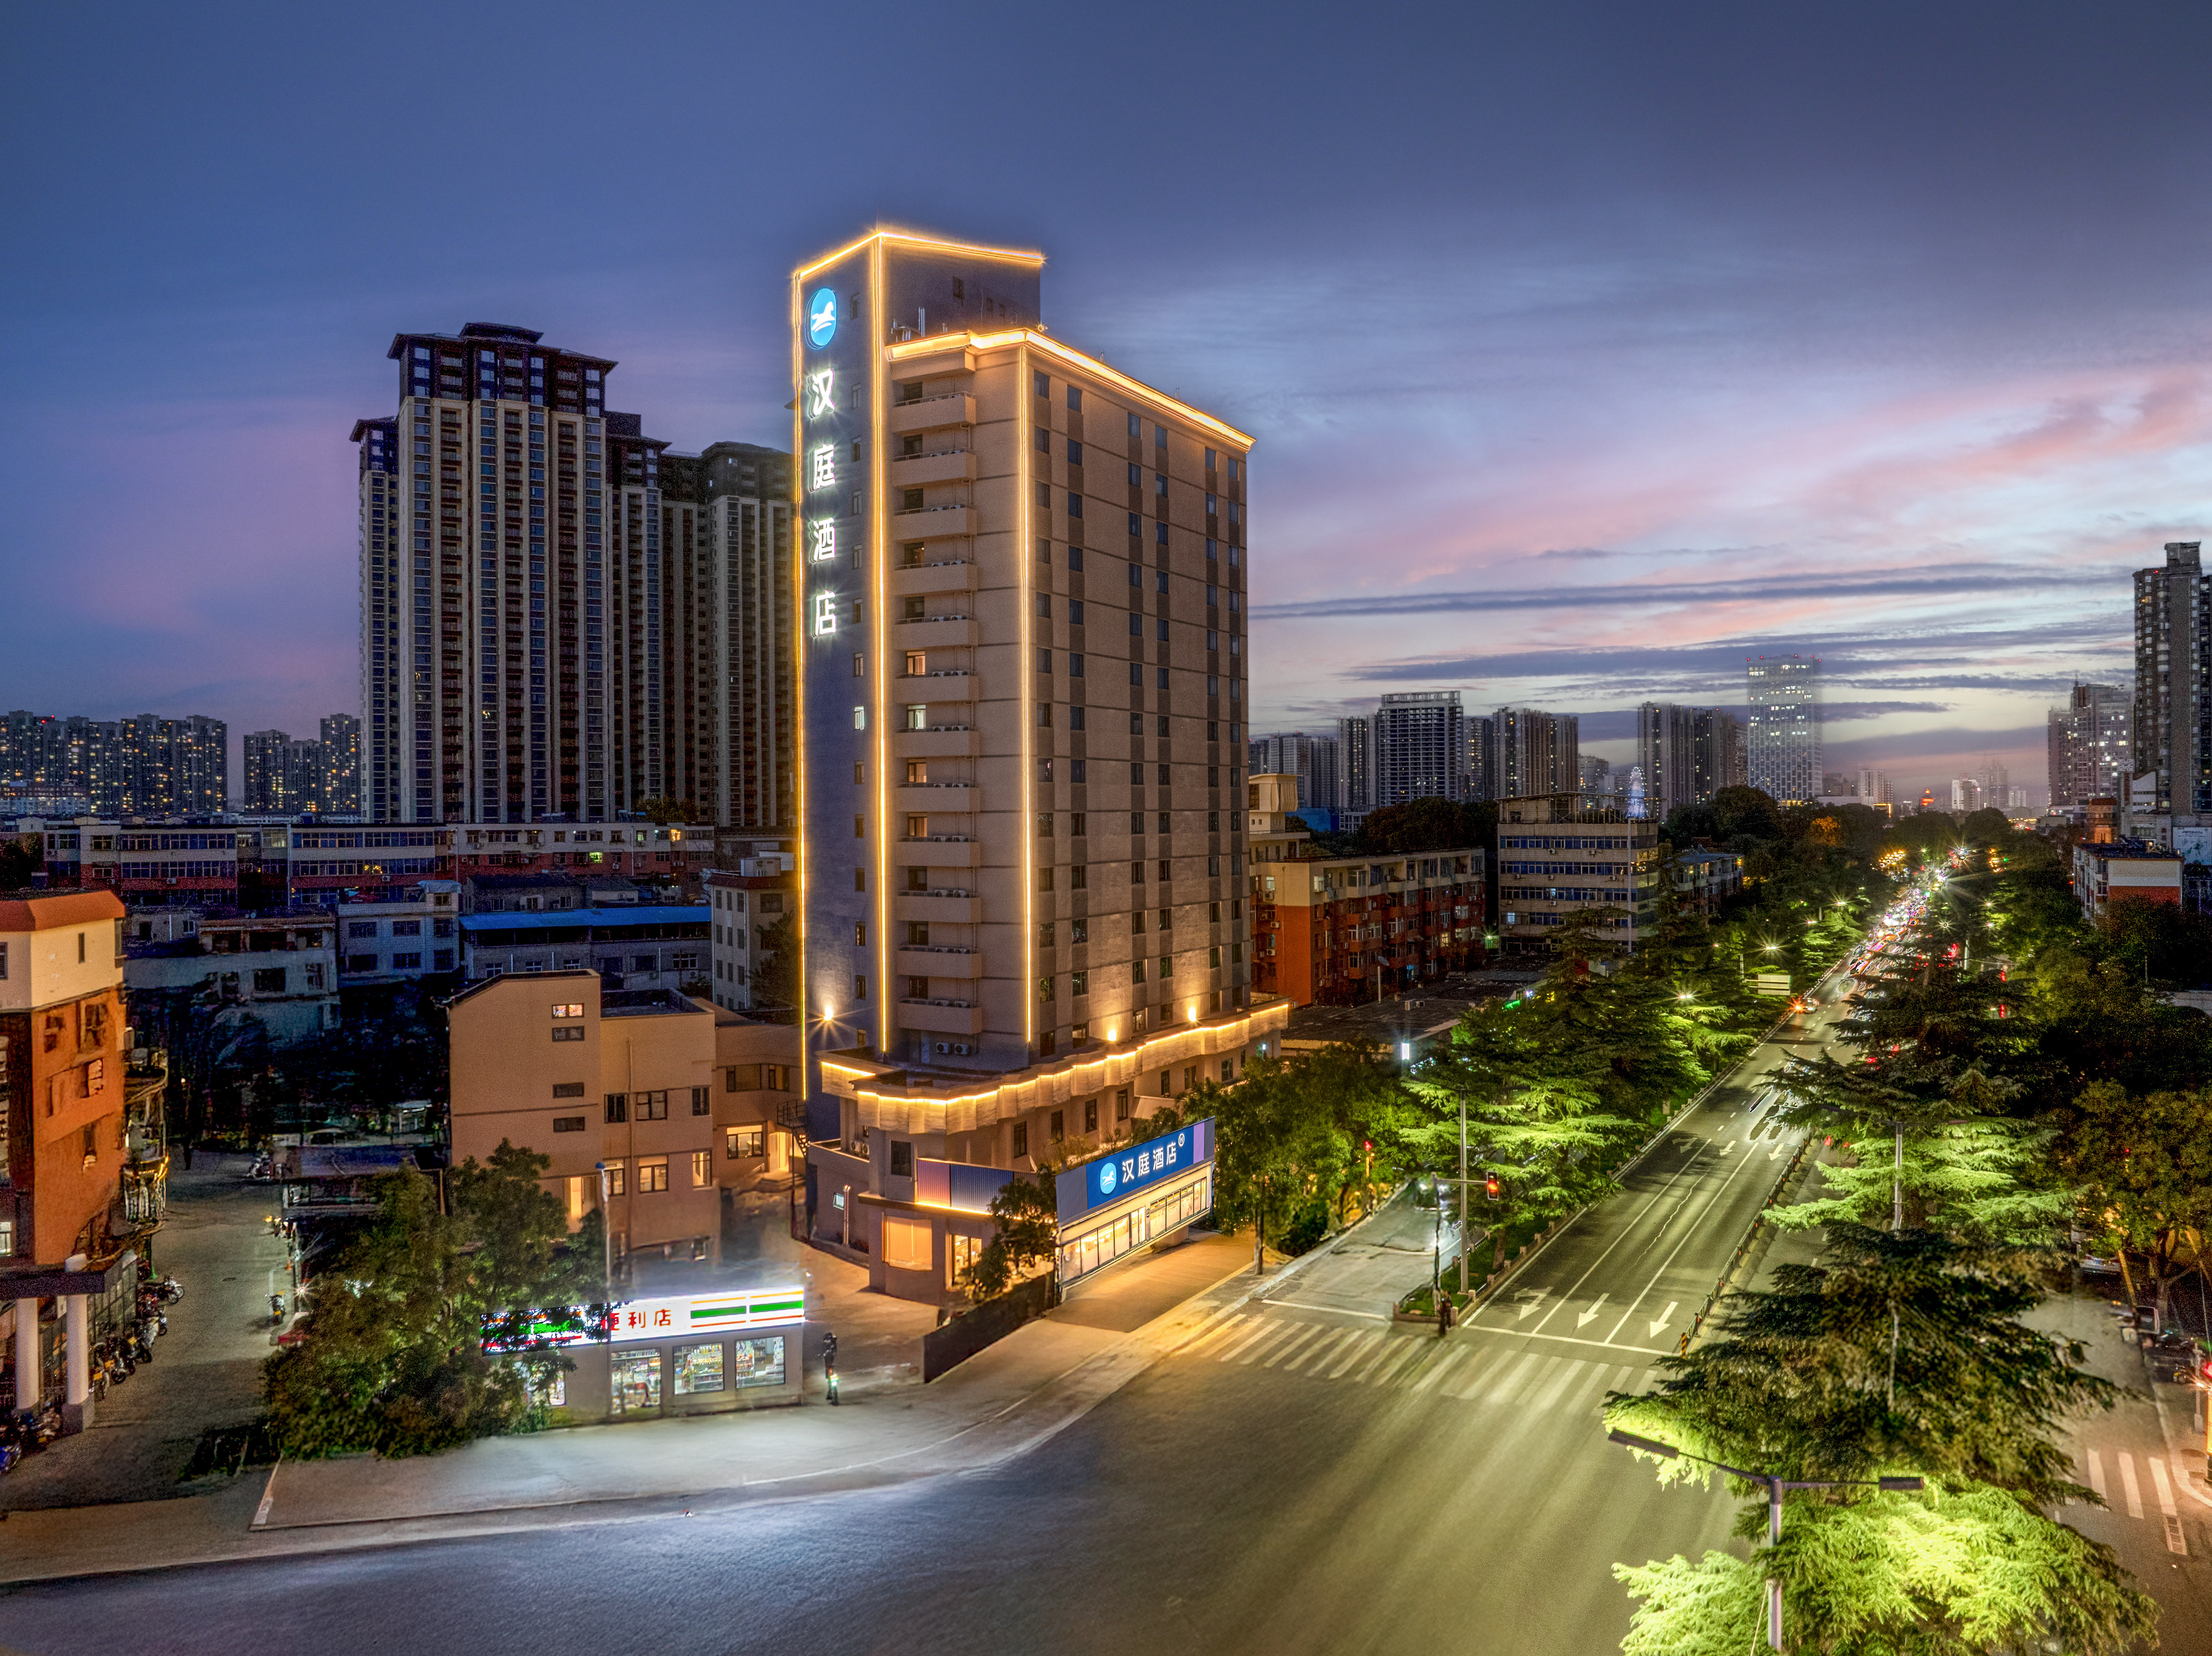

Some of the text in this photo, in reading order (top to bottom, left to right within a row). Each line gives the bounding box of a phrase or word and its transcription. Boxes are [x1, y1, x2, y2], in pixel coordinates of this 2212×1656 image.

[812, 368, 836, 635] 汉庭酒店
[1122, 1142, 1176, 1183] 汉庭酒店
